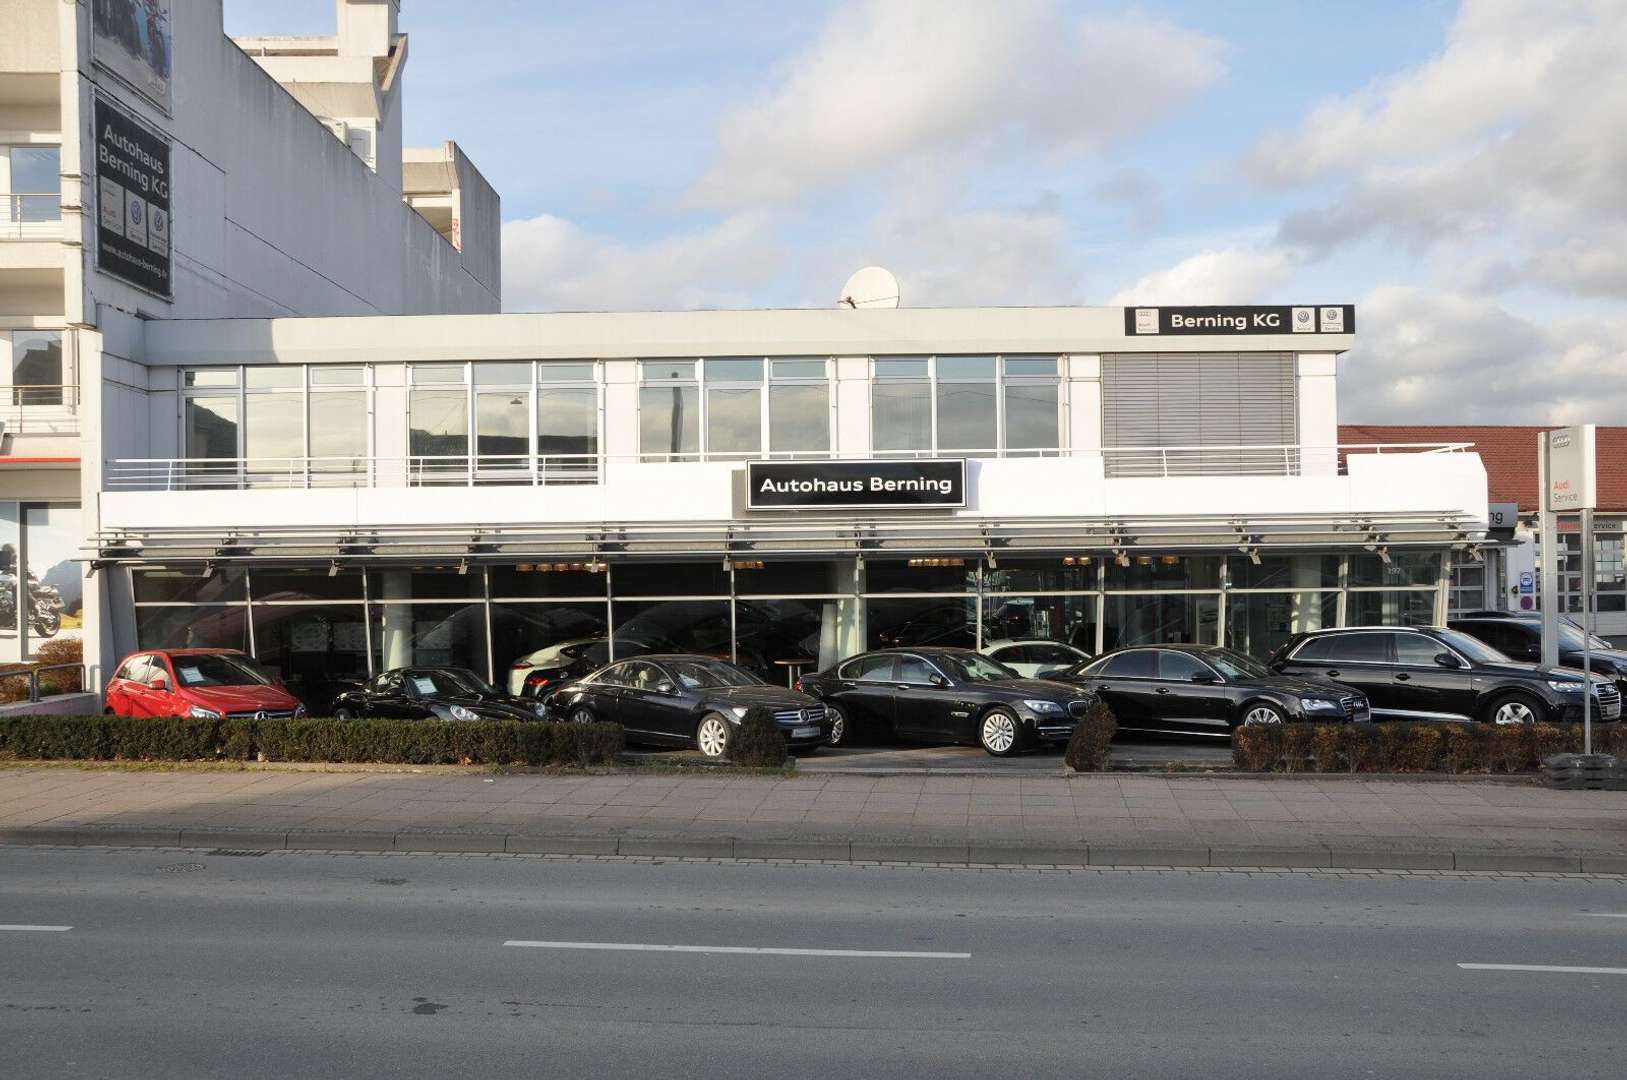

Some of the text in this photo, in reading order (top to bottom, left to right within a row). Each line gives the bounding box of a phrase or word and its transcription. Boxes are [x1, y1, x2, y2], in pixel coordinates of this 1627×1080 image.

[104, 124, 164, 174] Autohaus
[99, 144, 168, 199] Berning KG
[1171, 314, 1247, 330] Berning
[1253, 313, 1281, 327] KG
[760, 477, 952, 494] Autohaus Berning
[1553, 492, 1578, 503] Service
